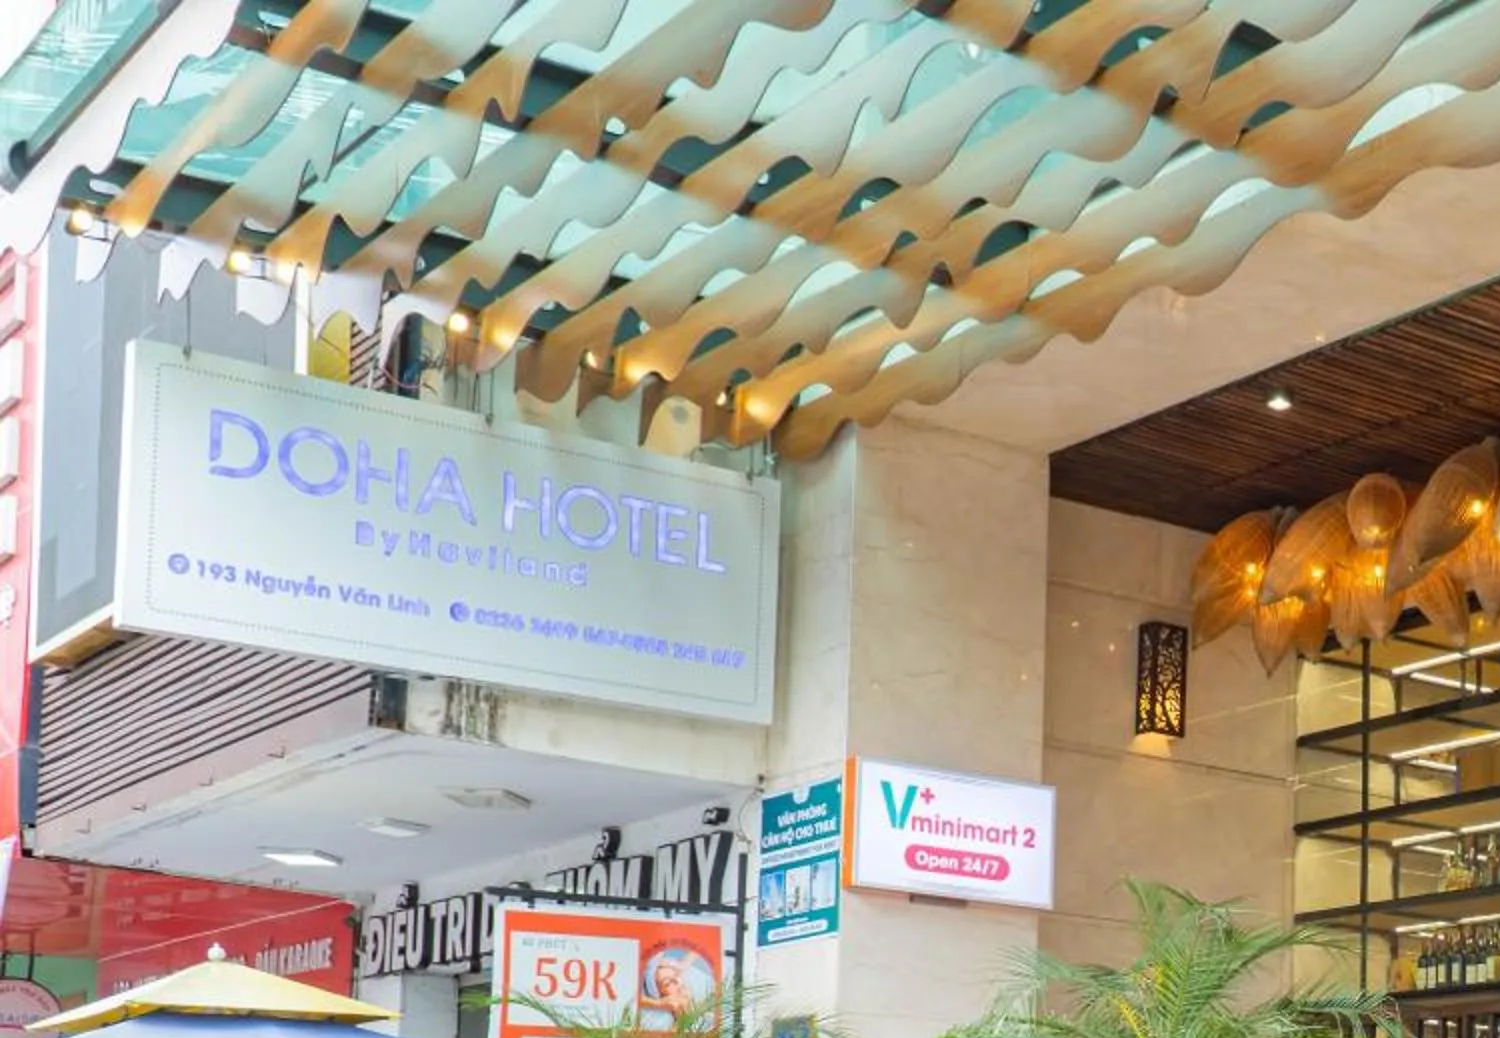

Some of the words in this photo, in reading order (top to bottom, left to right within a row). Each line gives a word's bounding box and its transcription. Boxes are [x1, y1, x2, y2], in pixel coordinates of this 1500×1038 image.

[208, 408, 478, 526] DOHA
[502, 470, 728, 573] HOTEL
[197, 559, 237, 583] 193
[245, 569, 331, 599] Nguyễn
[387, 593, 431, 618] Linh
[911, 814, 1017, 847] minimart
[1022, 828, 1036, 849] 2
[914, 850, 959, 872] Open
[962, 857, 999, 877] 24/7
[533, 956, 618, 1001] 59K
